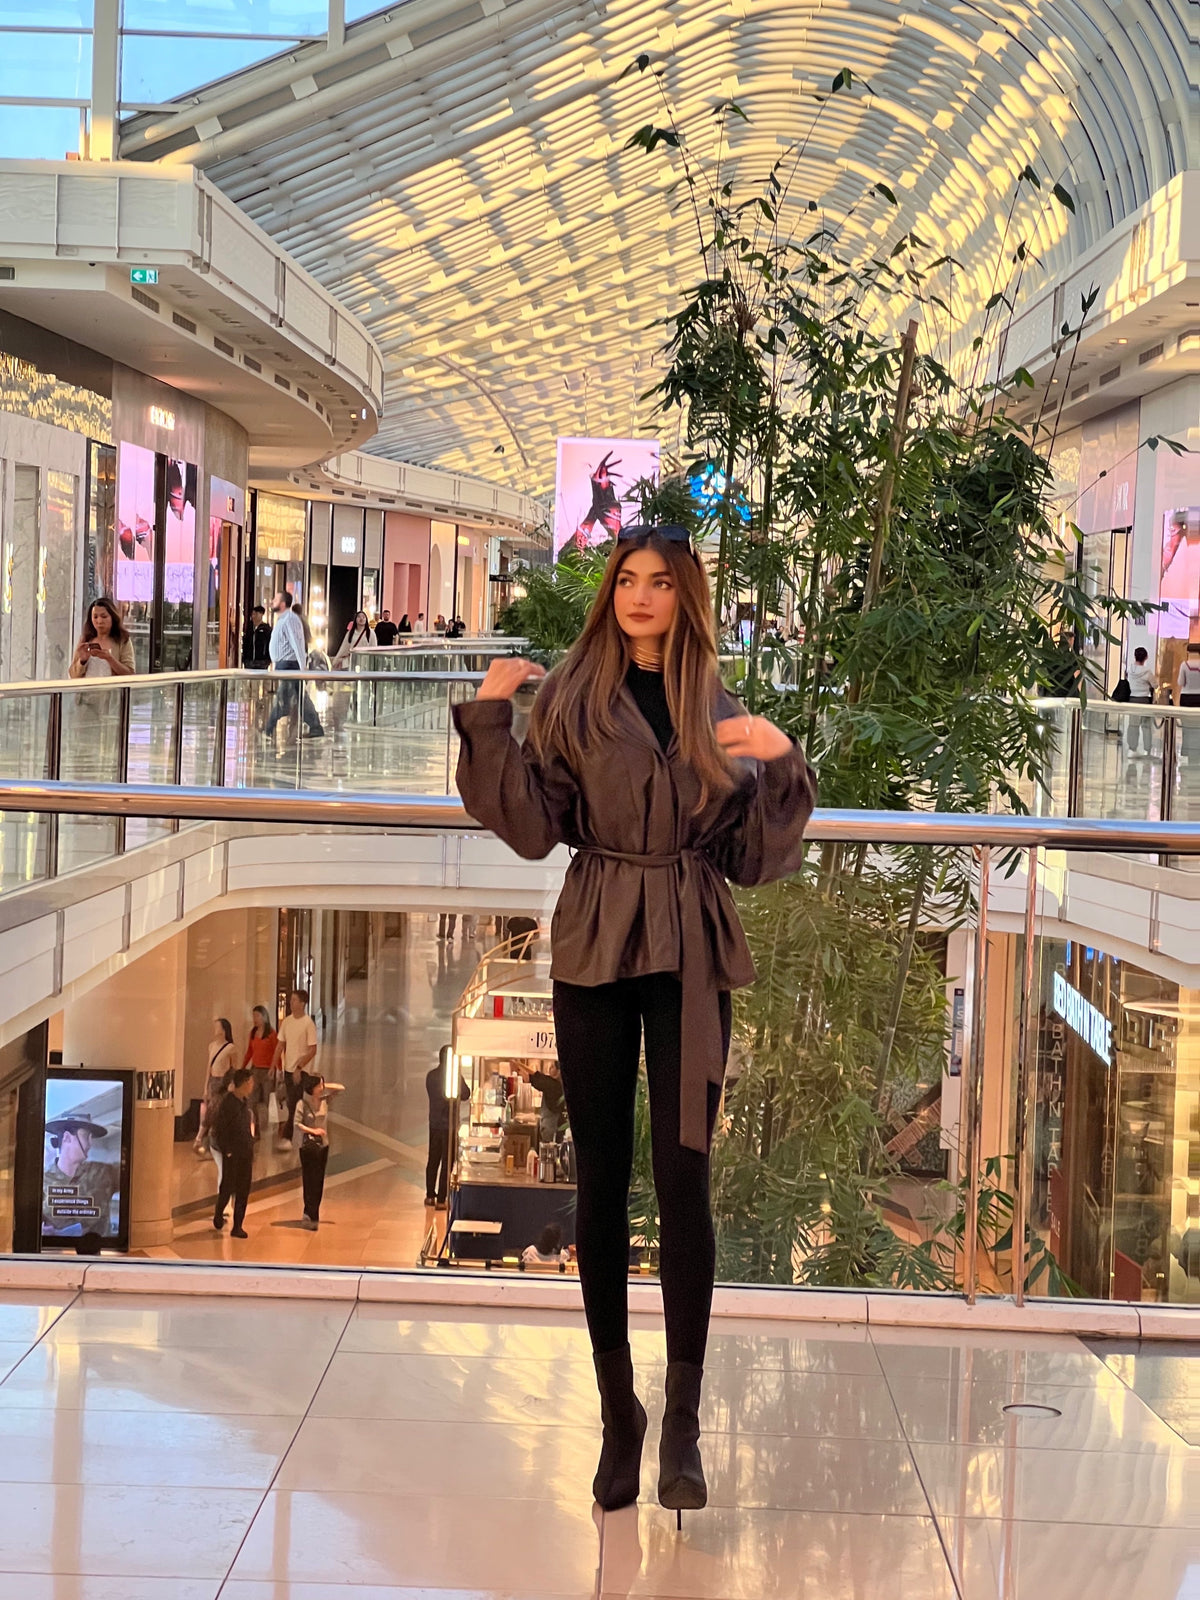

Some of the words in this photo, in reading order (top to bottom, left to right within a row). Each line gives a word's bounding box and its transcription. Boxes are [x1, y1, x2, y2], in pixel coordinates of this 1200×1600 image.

[1049, 1023, 1064, 1091] BATH
[1066, 983, 1084, 1039] BATH
[1090, 1004, 1112, 1067] TABLE
